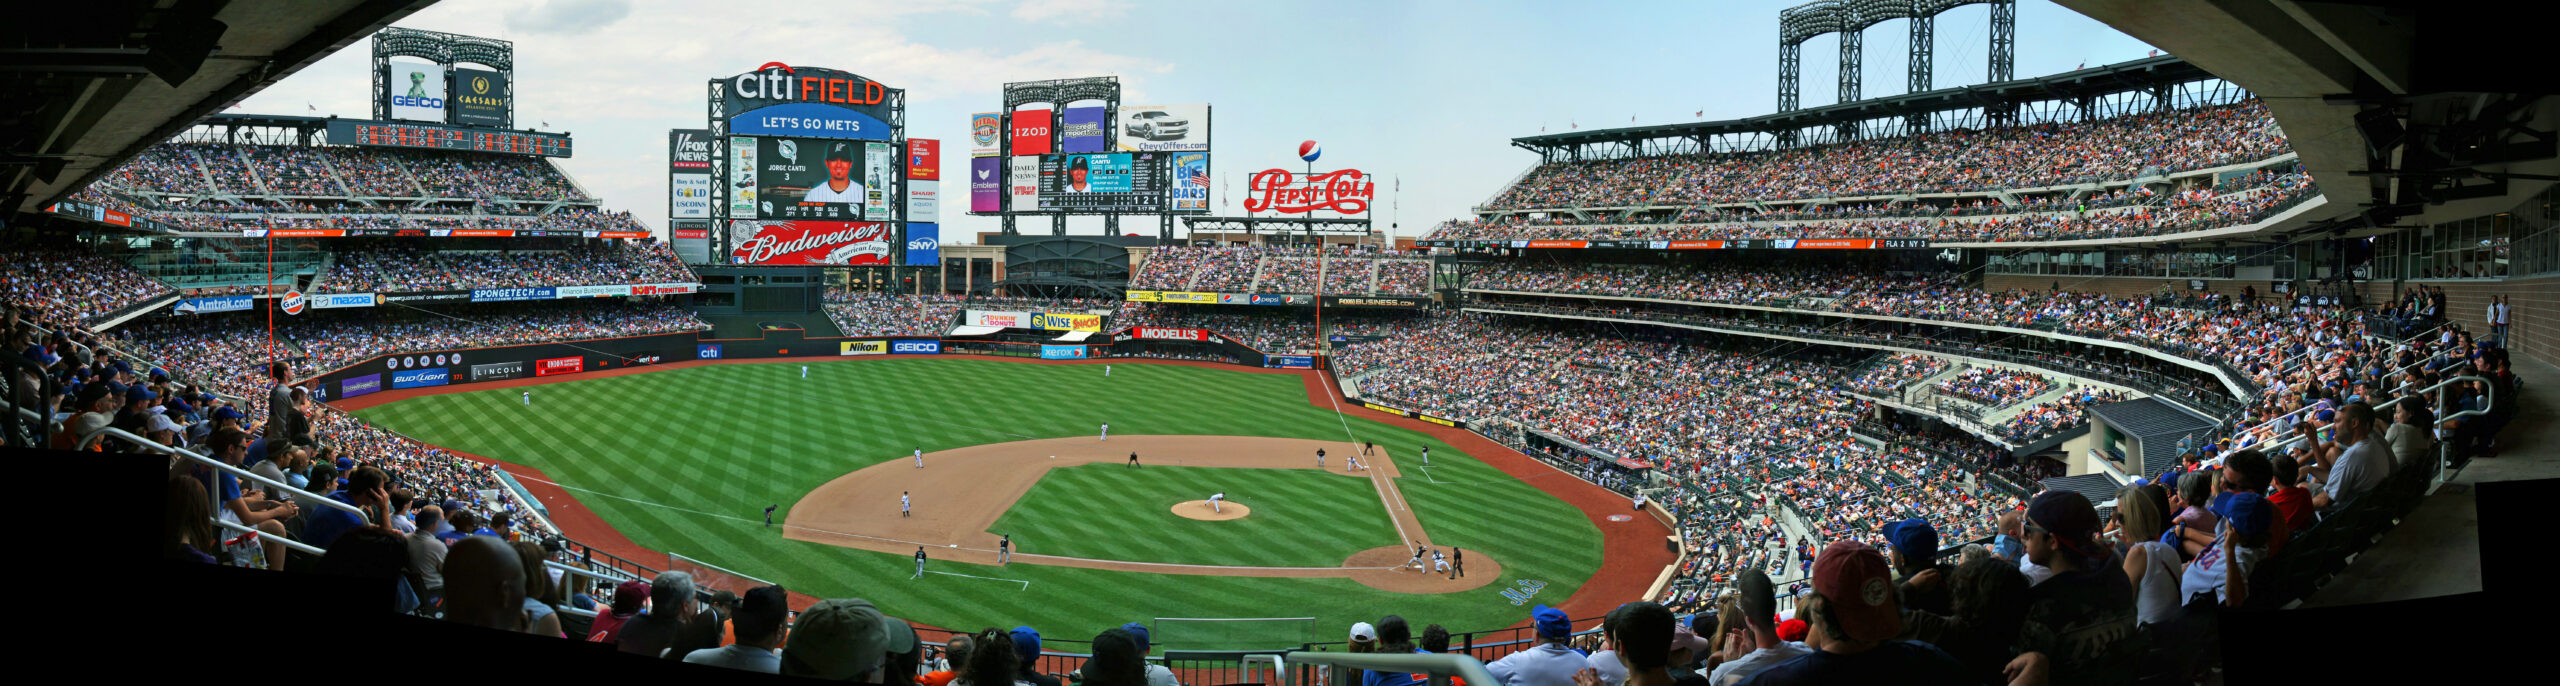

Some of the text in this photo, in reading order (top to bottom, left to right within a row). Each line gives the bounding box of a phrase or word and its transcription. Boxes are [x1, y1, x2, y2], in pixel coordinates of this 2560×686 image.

[736, 68, 884, 105] citi FIELD
[393, 95, 443, 109] GEICO
[458, 95, 503, 107] CAESARS
[762, 117, 860, 131] LET'S GO METS
[1015, 127, 1048, 137] IZOD
[685, 141, 708, 152] FOX
[1138, 142, 1207, 151] ChevyOffers.com
[679, 152, 709, 161] NEWS
[784, 173, 790, 181] 3
[676, 188, 706, 198] GOLD
[1173, 188, 1205, 198] BARS
[1134, 196, 1138, 204] 1
[1143, 196, 1148, 204] 2
[1154, 196, 1158, 204] 1
[740, 223, 881, 263] Budweiser
[908, 238, 937, 250] SNY
[836, 244, 886, 259] American Lager
[474, 288, 550, 298] SPONGETECH.com
[632, 286, 688, 295] BOB'S FURNITURE
[332, 296, 371, 305] mazda
[1154, 292, 1163, 302] $5
[198, 298, 253, 310] Amtrak.com
[283, 297, 302, 308] Gulf
[1046, 316, 1100, 329] WISE SNACKS
[1142, 328, 1198, 340] MODELL'S
[849, 343, 937, 351] Nikon GEICO
[1045, 348, 1072, 356] xerox
[701, 348, 717, 358] citi
[477, 366, 522, 376] LINCOLN
[1500, 578, 1549, 606] Mets
